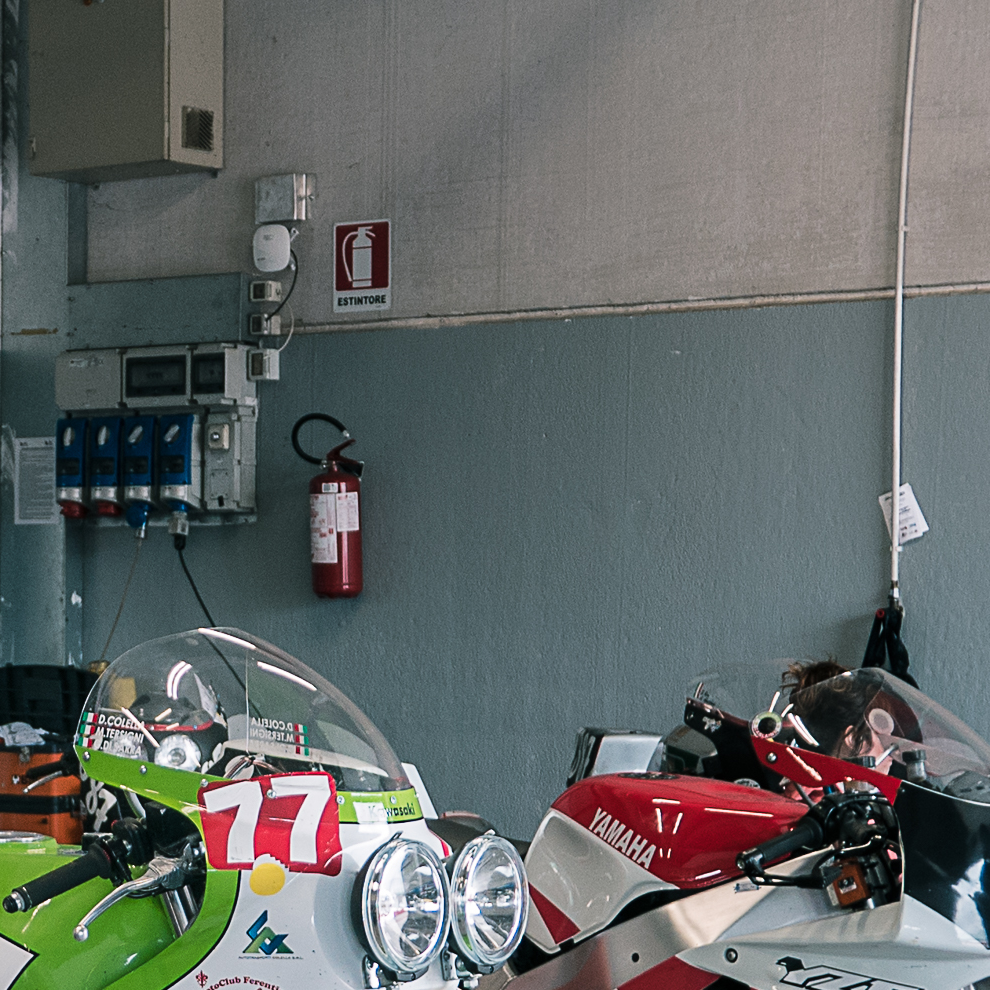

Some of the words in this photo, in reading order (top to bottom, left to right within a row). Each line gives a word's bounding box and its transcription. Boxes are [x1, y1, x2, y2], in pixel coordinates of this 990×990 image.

[337, 295, 387, 306] ESTINTORE
[202, 774, 331, 864] 77
[589, 807, 657, 869] YAMAHA
